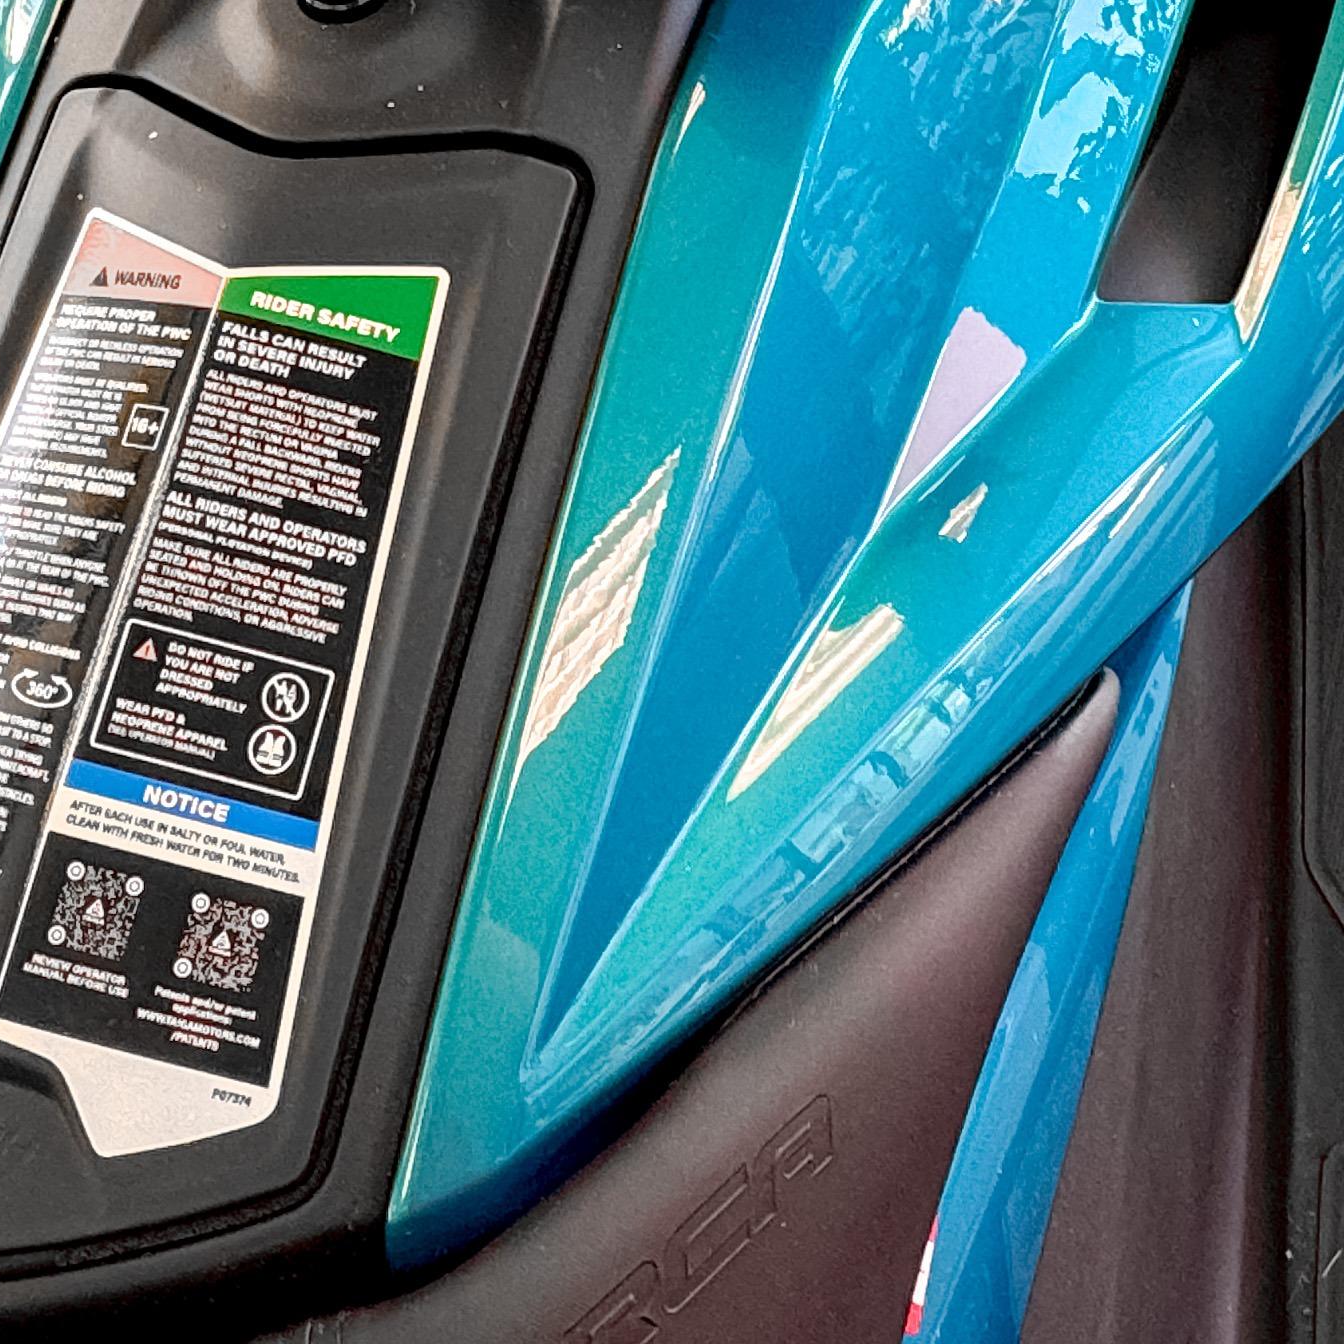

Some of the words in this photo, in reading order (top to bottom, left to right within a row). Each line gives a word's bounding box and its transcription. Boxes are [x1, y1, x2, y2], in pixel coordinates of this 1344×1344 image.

[114, 269, 182, 291] WARNING
[107, 307, 157, 322] PROPER
[249, 290, 316, 321] RIDER
[315, 307, 400, 344] SAFETY
[116, 322, 135, 334] OF
[135, 323, 161, 337] THE
[160, 326, 192, 340] PWC
[220, 320, 271, 343] FALLS
[270, 332, 305, 352] CAN
[306, 342, 367, 369] RESULT
[212, 348, 236, 364] OR
[236, 354, 291, 378] DEATH
[216, 334, 236, 349] IN
[236, 339, 298, 365] SEVERE
[298, 355, 354, 381] INJURY
[205, 366, 226, 381] ALL
[130, 416, 161, 435] 16+
[218, 419, 239, 433] THE
[282, 437, 299, 449] OR
[302, 417, 318, 430] TO
[228, 434, 238, 445] A
[43, 474, 86, 492] BEFORE
[84, 480, 126, 498] RIDING
[83, 465, 139, 485] ALCOHOL
[161, 504, 203, 526] MUST
[203, 515, 247, 538] WEAR
[247, 526, 326, 559] APPROVED
[326, 547, 357, 567] PFD
[165, 489, 194, 508] ALL
[194, 497, 247, 522] RIDERS
[247, 511, 280, 531] AND
[281, 520, 367, 554] OPERATORS
[151, 535, 183, 554] MAKE
[210, 551, 233, 567] ALL
[270, 567, 293, 583] ARE
[187, 558, 213, 574] AND
[321, 593, 345, 609] CAN
[206, 576, 230, 592] OFF
[229, 582, 251, 598] THE
[251, 588, 276, 605] PWC
[242, 613, 260, 627] OR
[163, 654, 189, 671] YOU
[189, 661, 213, 677] ARE
[214, 667, 240, 684] NOT
[167, 640, 186, 655] DO
[187, 646, 212, 662] NOT
[212, 652, 241, 670] RIDE
[241, 660, 254, 673] IF
[159, 668, 214, 691] DRESSED
[114, 697, 150, 716] WEAR
[150, 706, 175, 722] PFD
[155, 681, 247, 714] APPROPRIATELY
[110, 711, 175, 737] NEOPRENE
[174, 727, 229, 751] APPAREL
[141, 783, 230, 823] NOTICE
[64, 813, 100, 832] CLEAN
[100, 823, 129, 839] WITH
[129, 830, 164, 848] FRESH
[165, 839, 201, 858] WATER
[202, 849, 223, 864] FOR
[225, 855, 250, 871] TWO
[69, 799, 102, 817] AFTER
[103, 808, 133, 825] EACH
[133, 816, 154, 831] USE
[156, 822, 168, 835] IN
[169, 825, 201, 843] SALTY
[202, 833, 218, 848] OR
[219, 838, 247, 856] FOUL
